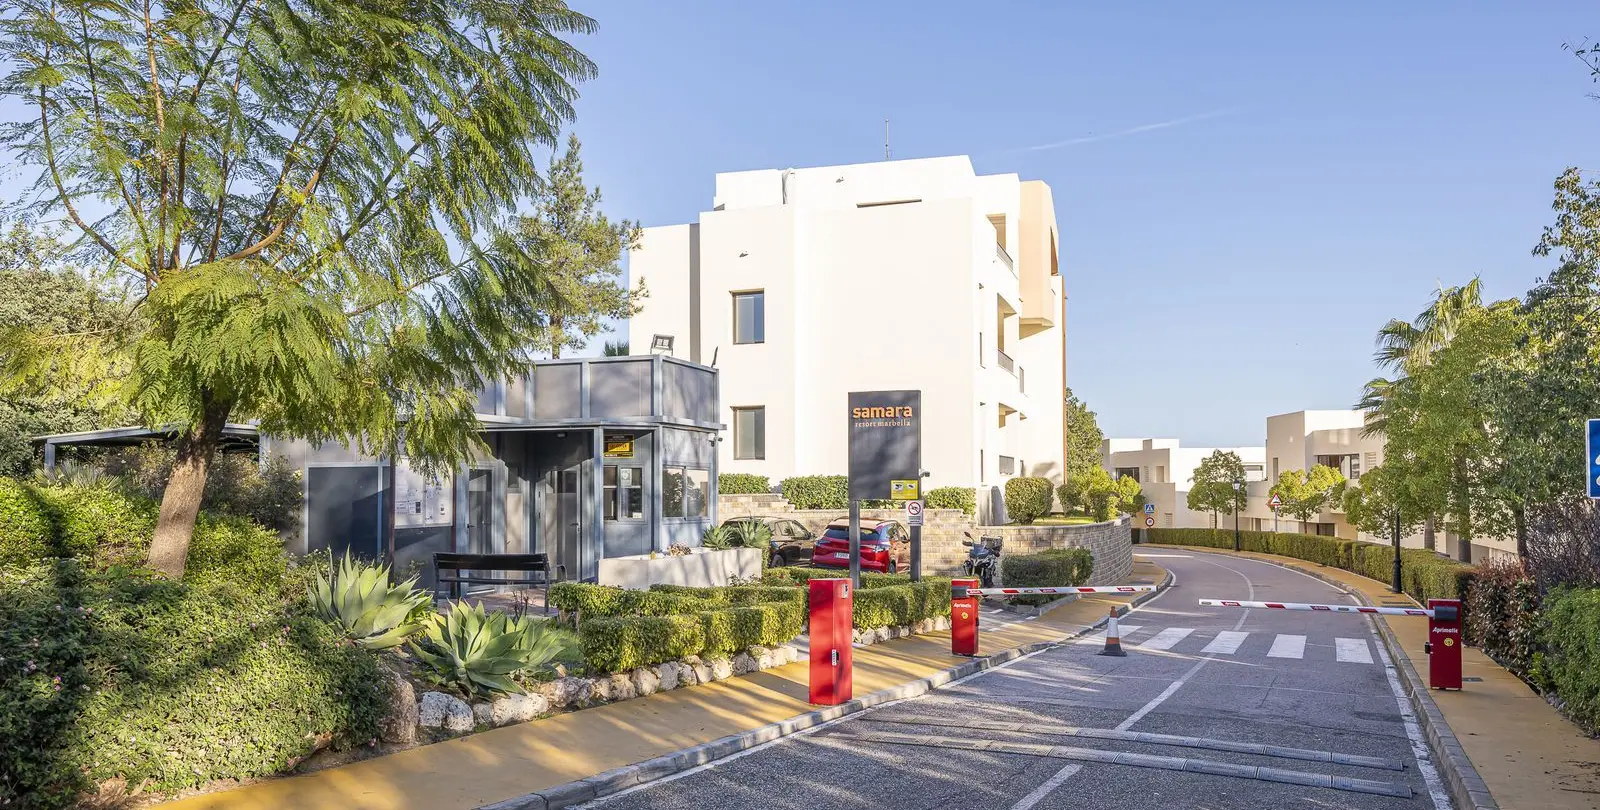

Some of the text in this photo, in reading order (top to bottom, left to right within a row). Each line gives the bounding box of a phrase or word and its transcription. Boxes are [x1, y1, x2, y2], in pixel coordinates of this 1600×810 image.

[853, 406, 913, 418] samara
[877, 419, 911, 427] marbella
[1432, 626, 1459, 634] Aprimatic
